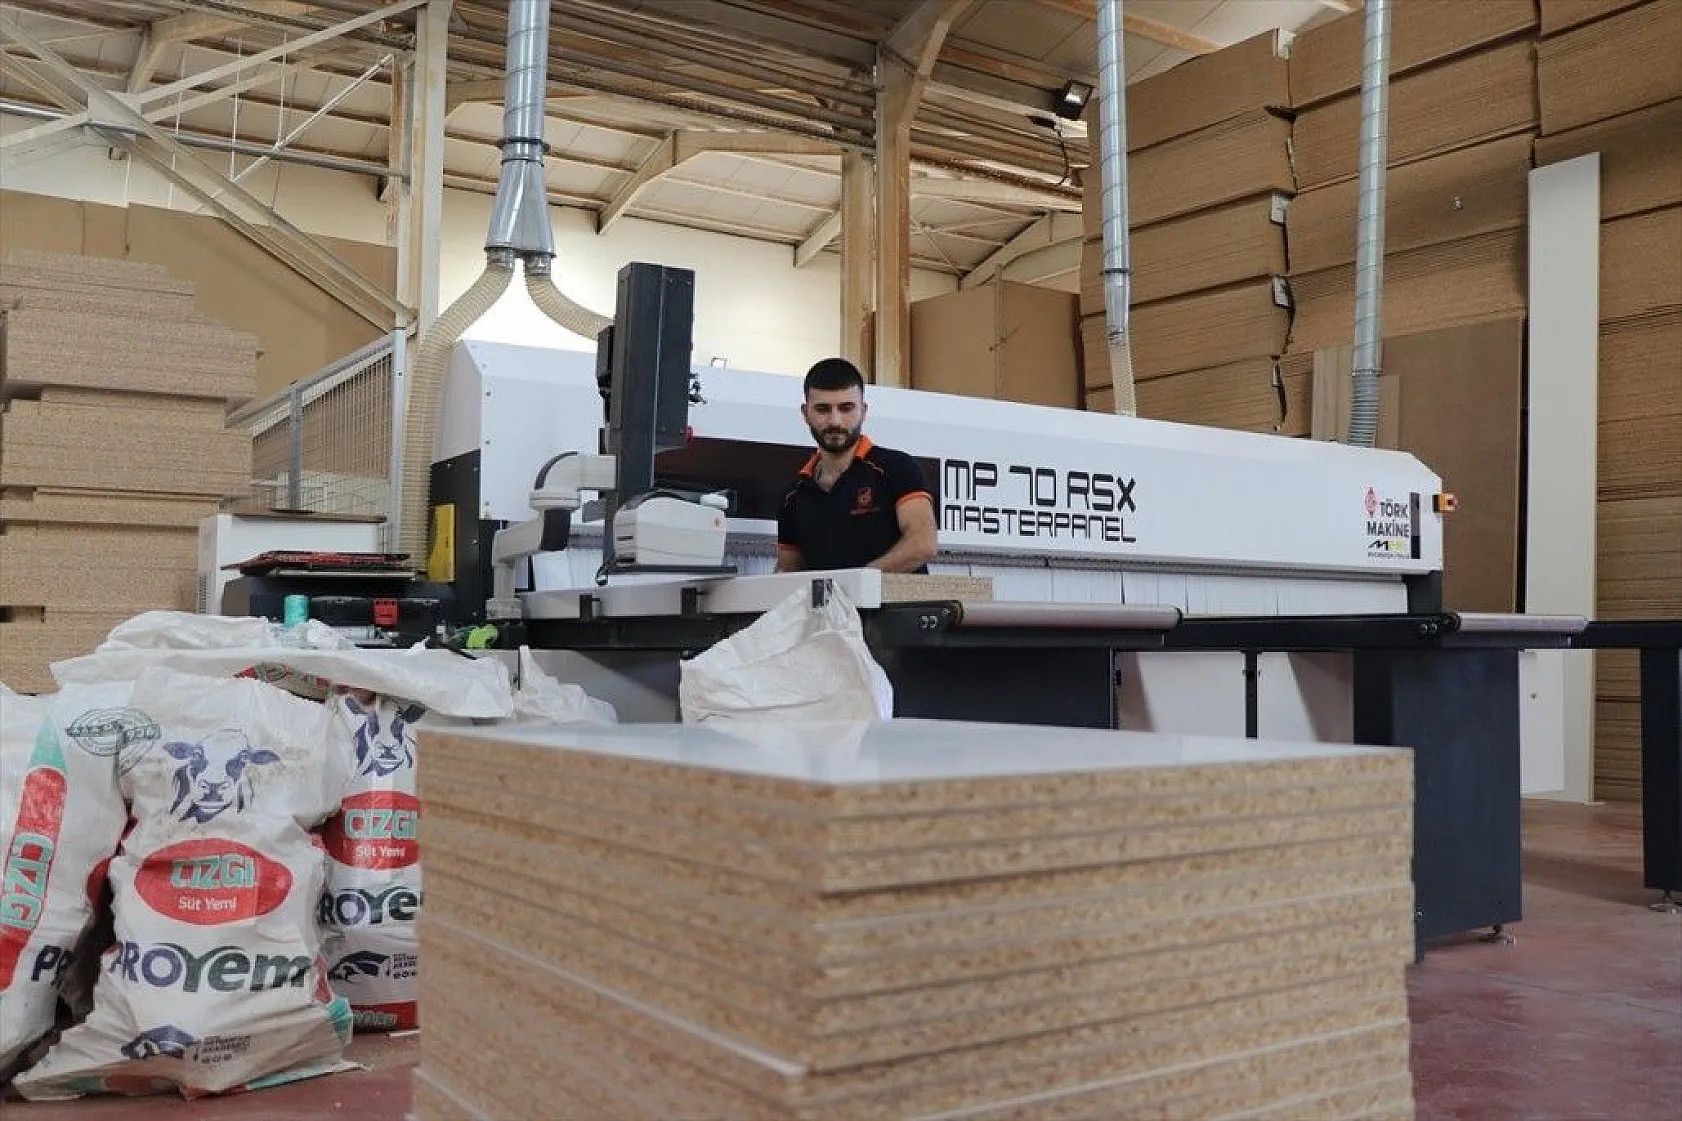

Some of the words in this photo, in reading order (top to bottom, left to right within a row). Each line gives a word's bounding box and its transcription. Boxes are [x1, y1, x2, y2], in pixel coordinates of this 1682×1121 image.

[945, 458, 998, 501] MP
[1009, 465, 1057, 507] 70
[1067, 471, 1137, 512] RSX
[945, 504, 1137, 543] MASTERPANEL
[1379, 498, 1408, 518] TÖRK
